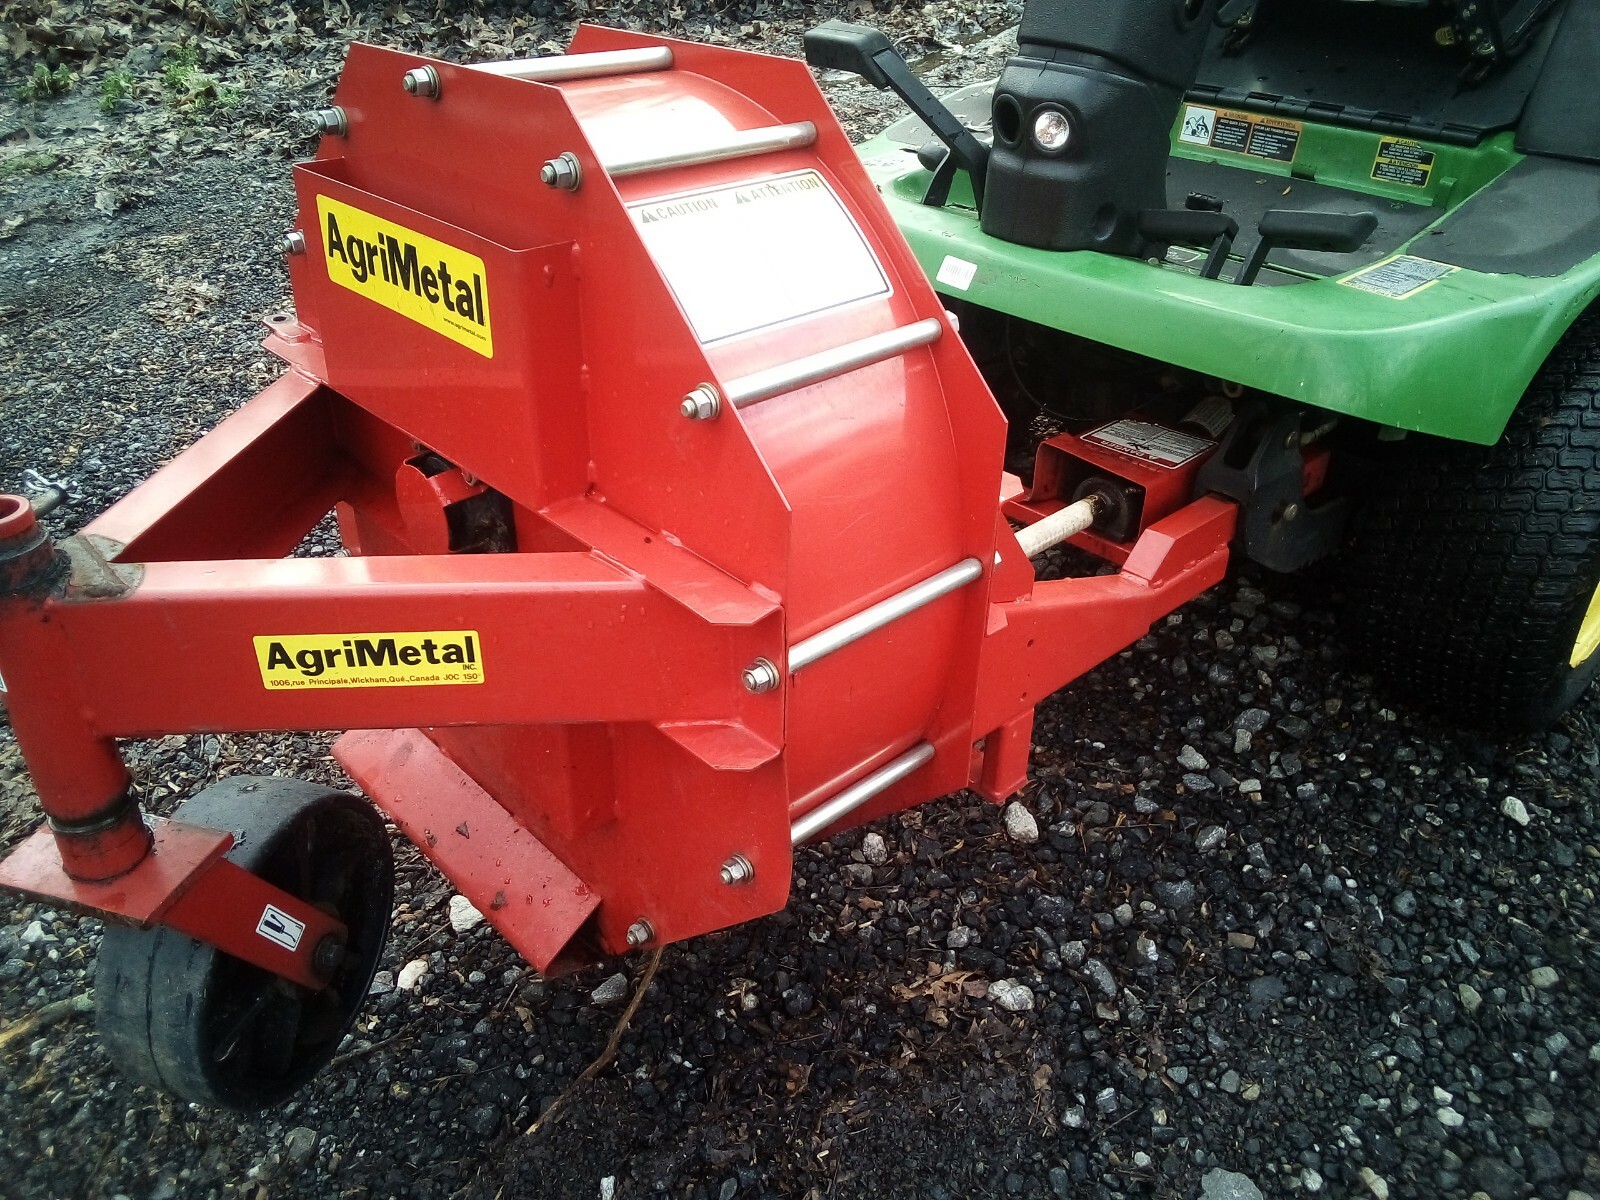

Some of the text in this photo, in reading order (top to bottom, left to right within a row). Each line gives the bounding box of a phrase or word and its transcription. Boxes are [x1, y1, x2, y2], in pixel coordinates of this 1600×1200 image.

[655, 178, 819, 219] CAUTION ATTENTION
[327, 211, 485, 327] AgriMetal
[267, 635, 476, 677] AgriMetal
